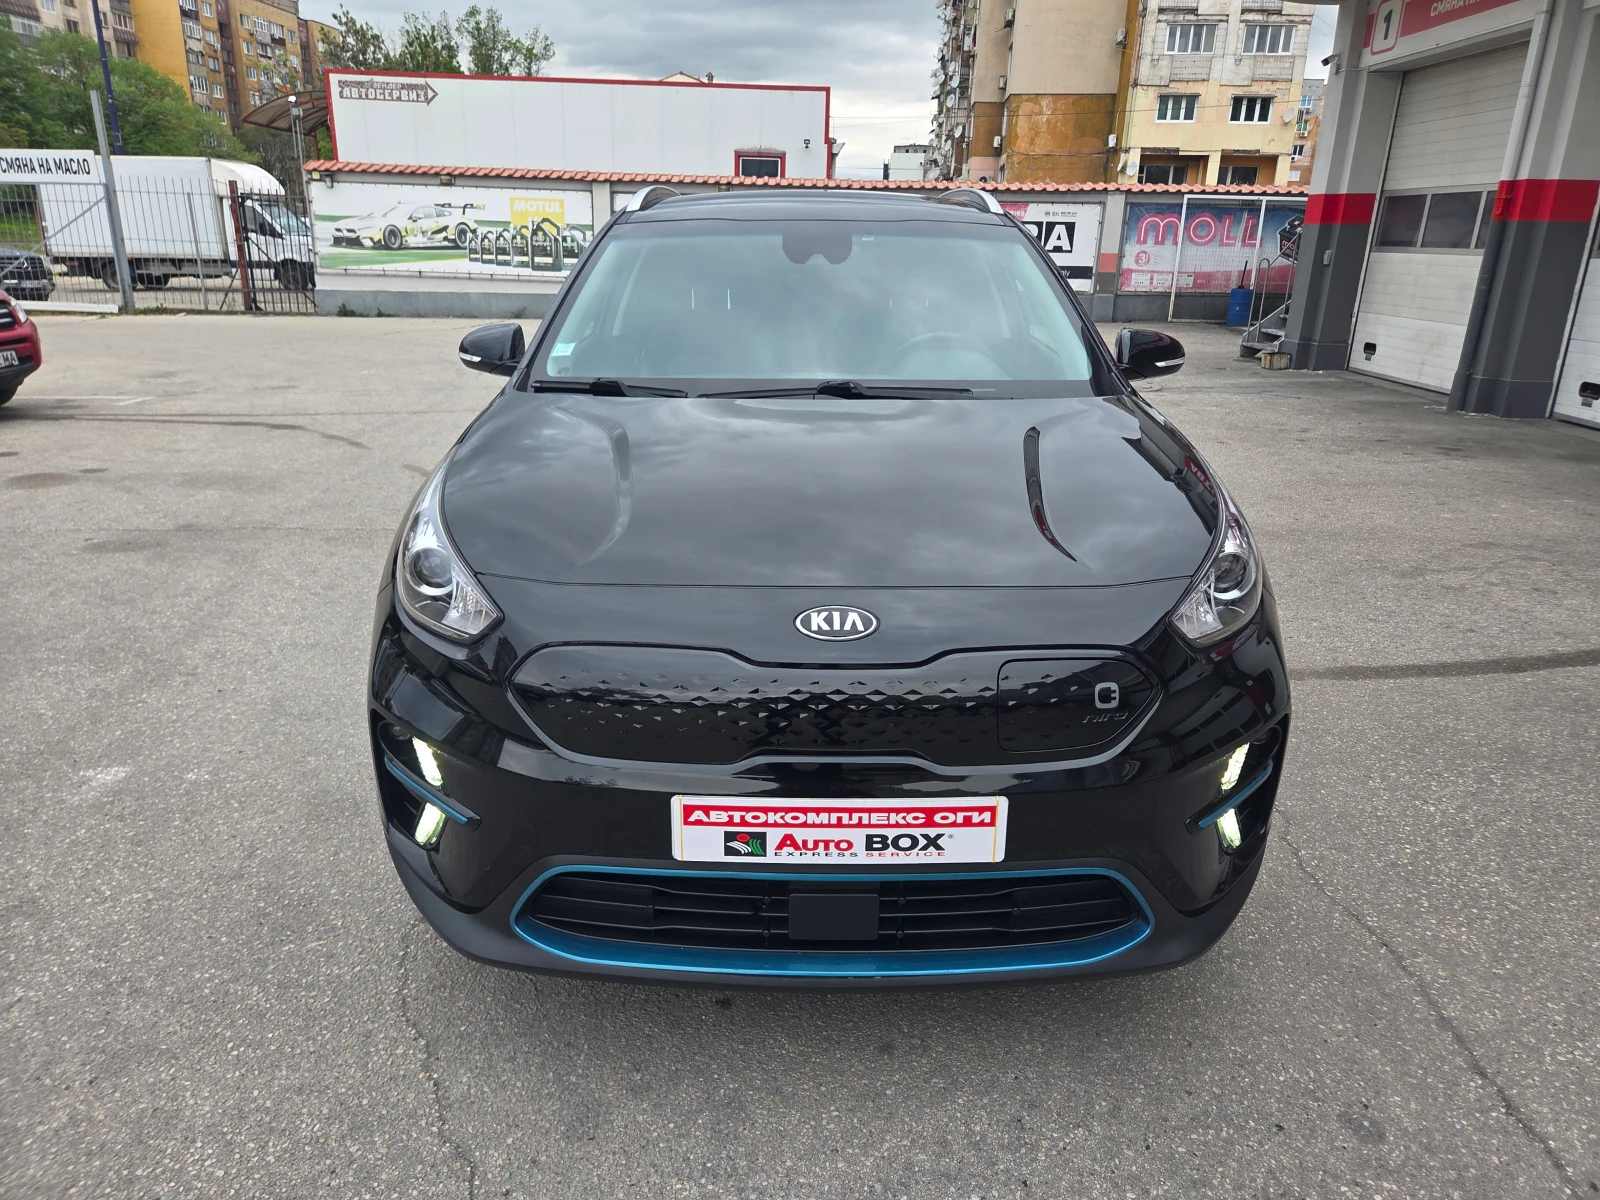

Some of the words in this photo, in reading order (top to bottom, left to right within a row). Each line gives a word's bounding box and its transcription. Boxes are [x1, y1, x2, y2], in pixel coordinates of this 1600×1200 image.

[1383, 9, 1393, 41] 1
[342, 87, 425, 102] АВТОСЕРВИЗ
[0, 156, 37, 174] СМЯНА
[37, 157, 53, 174] НА
[53, 157, 91, 175] МАСЛО
[513, 199, 562, 213] MOTUL
[809, 611, 865, 631] KIA
[687, 810, 927, 825] АВТОКОМПЛЕКС
[933, 811, 992, 825] ОГИ
